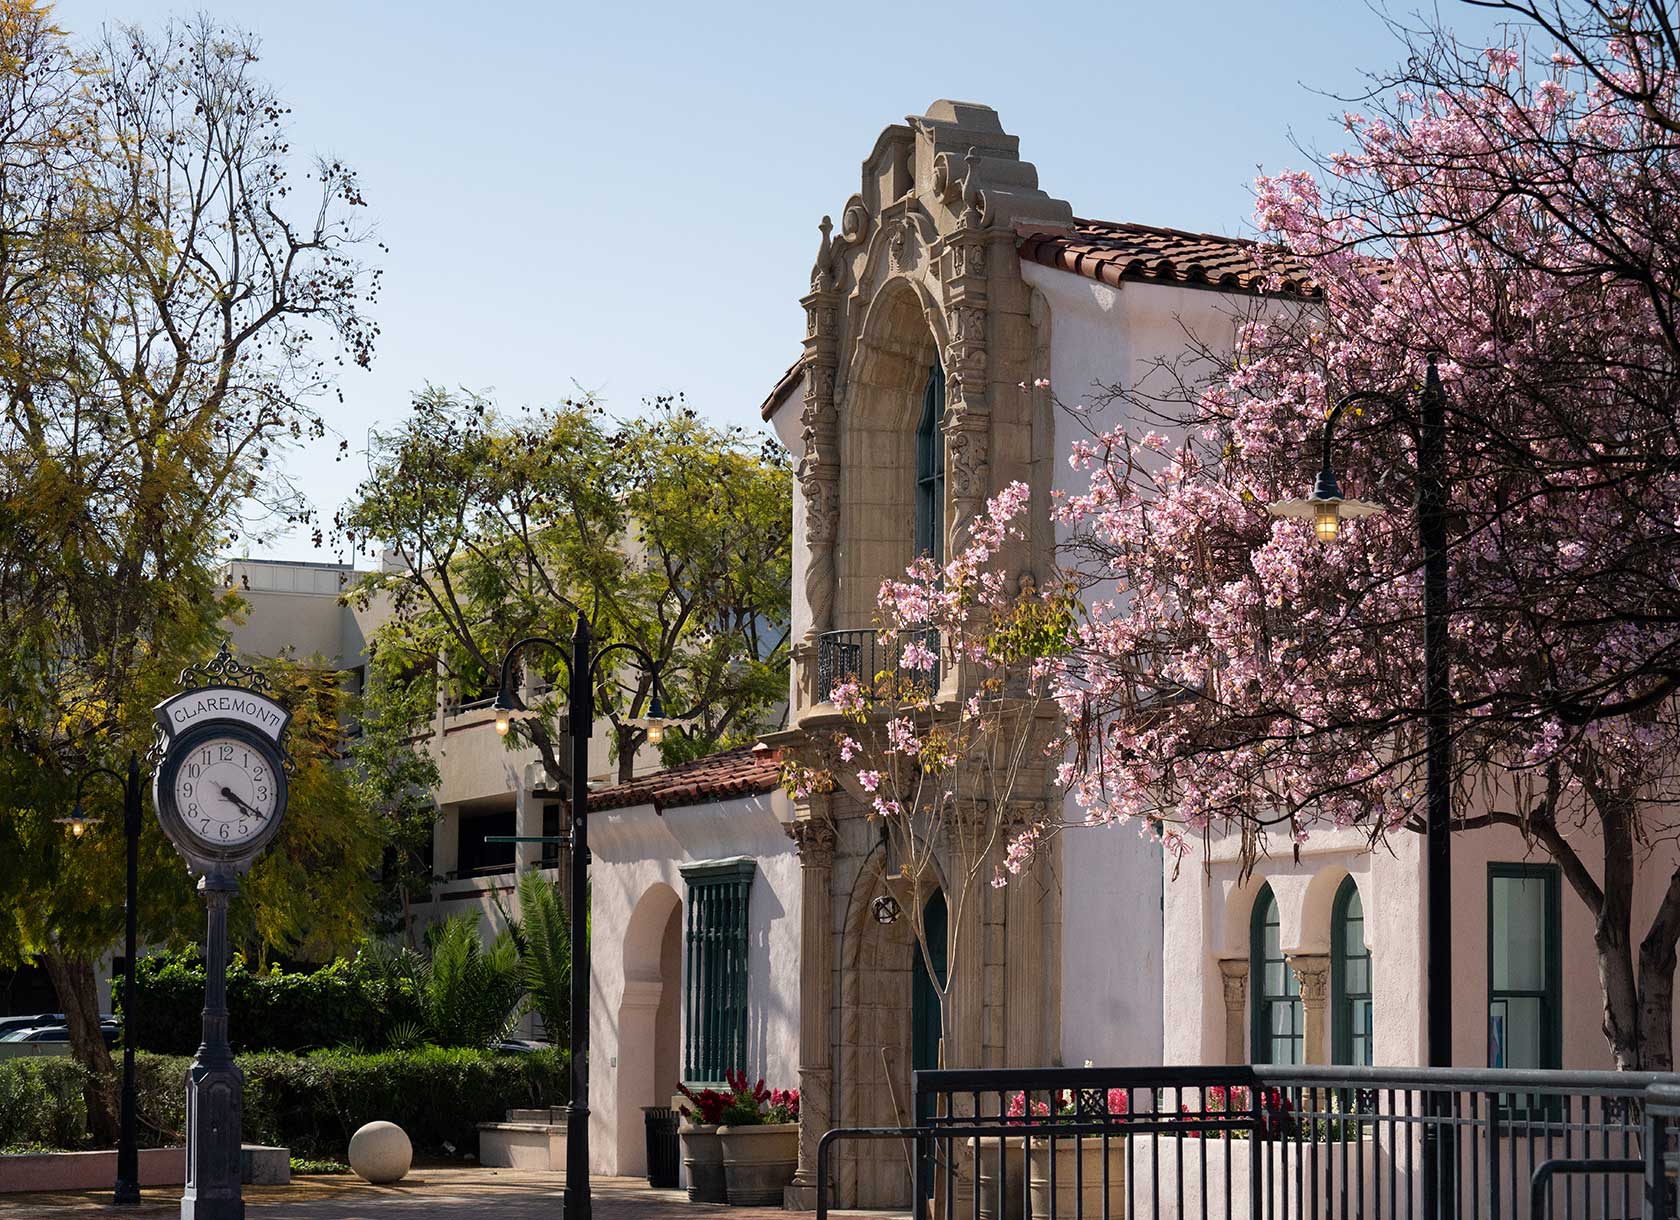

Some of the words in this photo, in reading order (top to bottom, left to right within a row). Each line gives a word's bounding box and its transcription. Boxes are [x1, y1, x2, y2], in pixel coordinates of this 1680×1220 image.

[174, 697, 281, 728] CLAREMONT
[202, 750, 211, 765] 11
[219, 745, 234, 761] 12
[243, 753, 248, 768] 1
[188, 763, 200, 778] 10
[253, 766, 263, 781] 2
[183, 782, 193, 798] 9
[256, 785, 267, 801] 3
[187, 803, 198, 818] 8
[200, 818, 210, 834] 7
[219, 823, 230, 839] 6
[238, 817, 248, 834] 5
